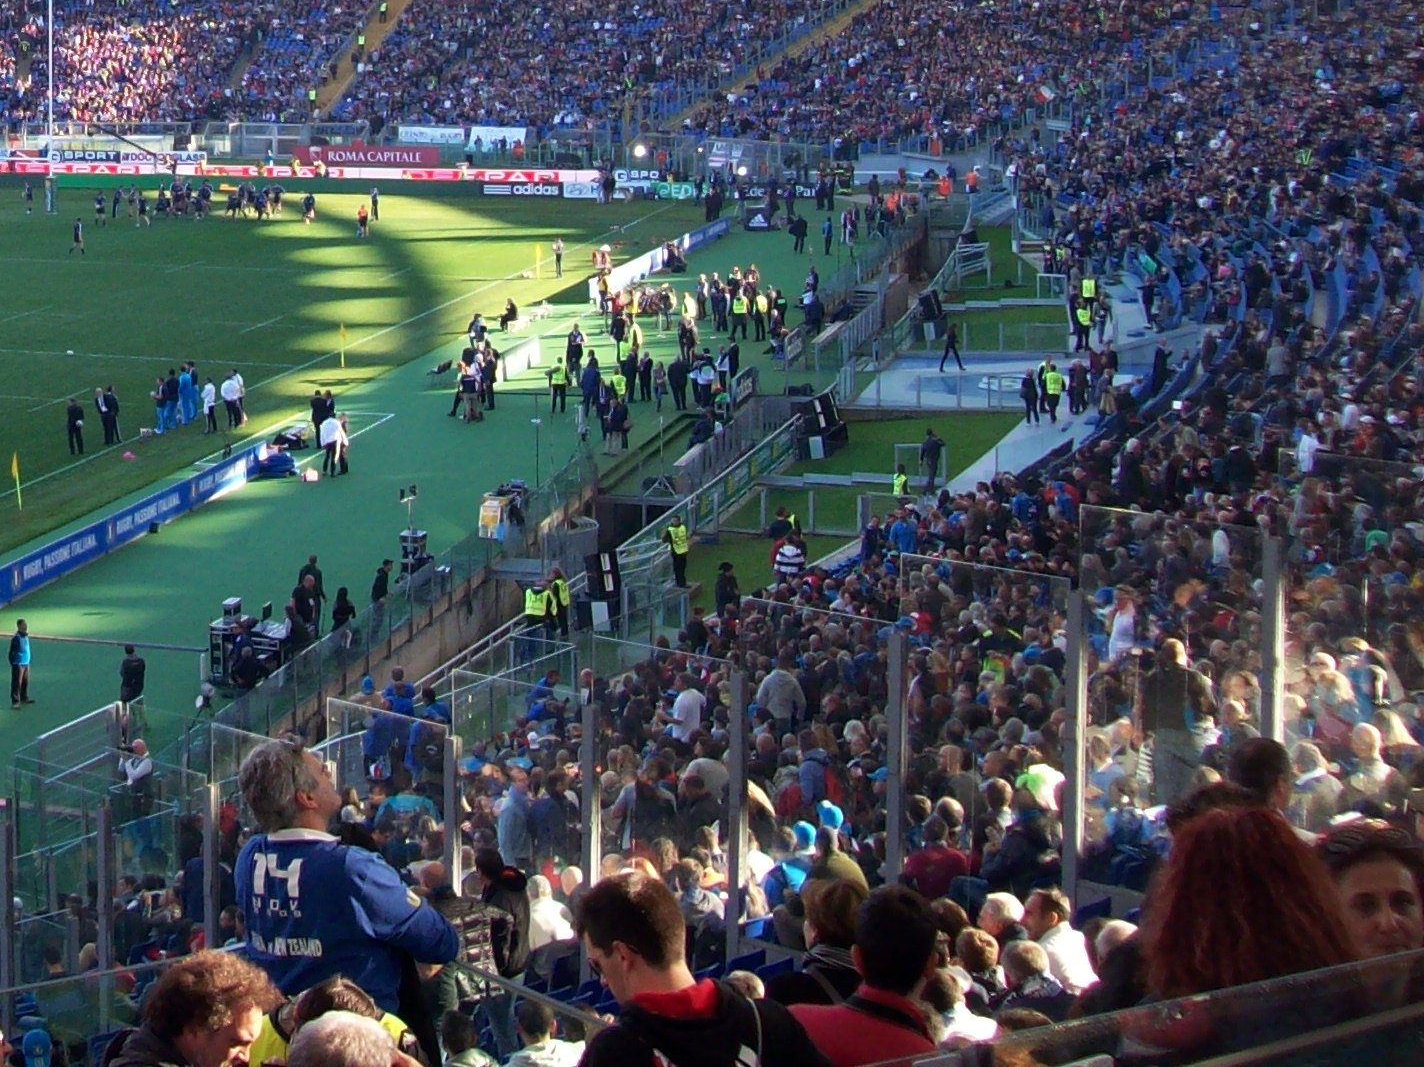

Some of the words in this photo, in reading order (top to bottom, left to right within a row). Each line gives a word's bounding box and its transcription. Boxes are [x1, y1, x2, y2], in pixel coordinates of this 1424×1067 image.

[64, 152, 116, 161] SPORT
[328, 151, 365, 162] ROMA
[367, 150, 422, 163] CAPITALE
[631, 170, 660, 179] SPO
[513, 183, 559, 195] adidas
[745, 187, 764, 197] Ede
[253, 852, 304, 898] 14
[287, 938, 323, 958] ZEALAND
